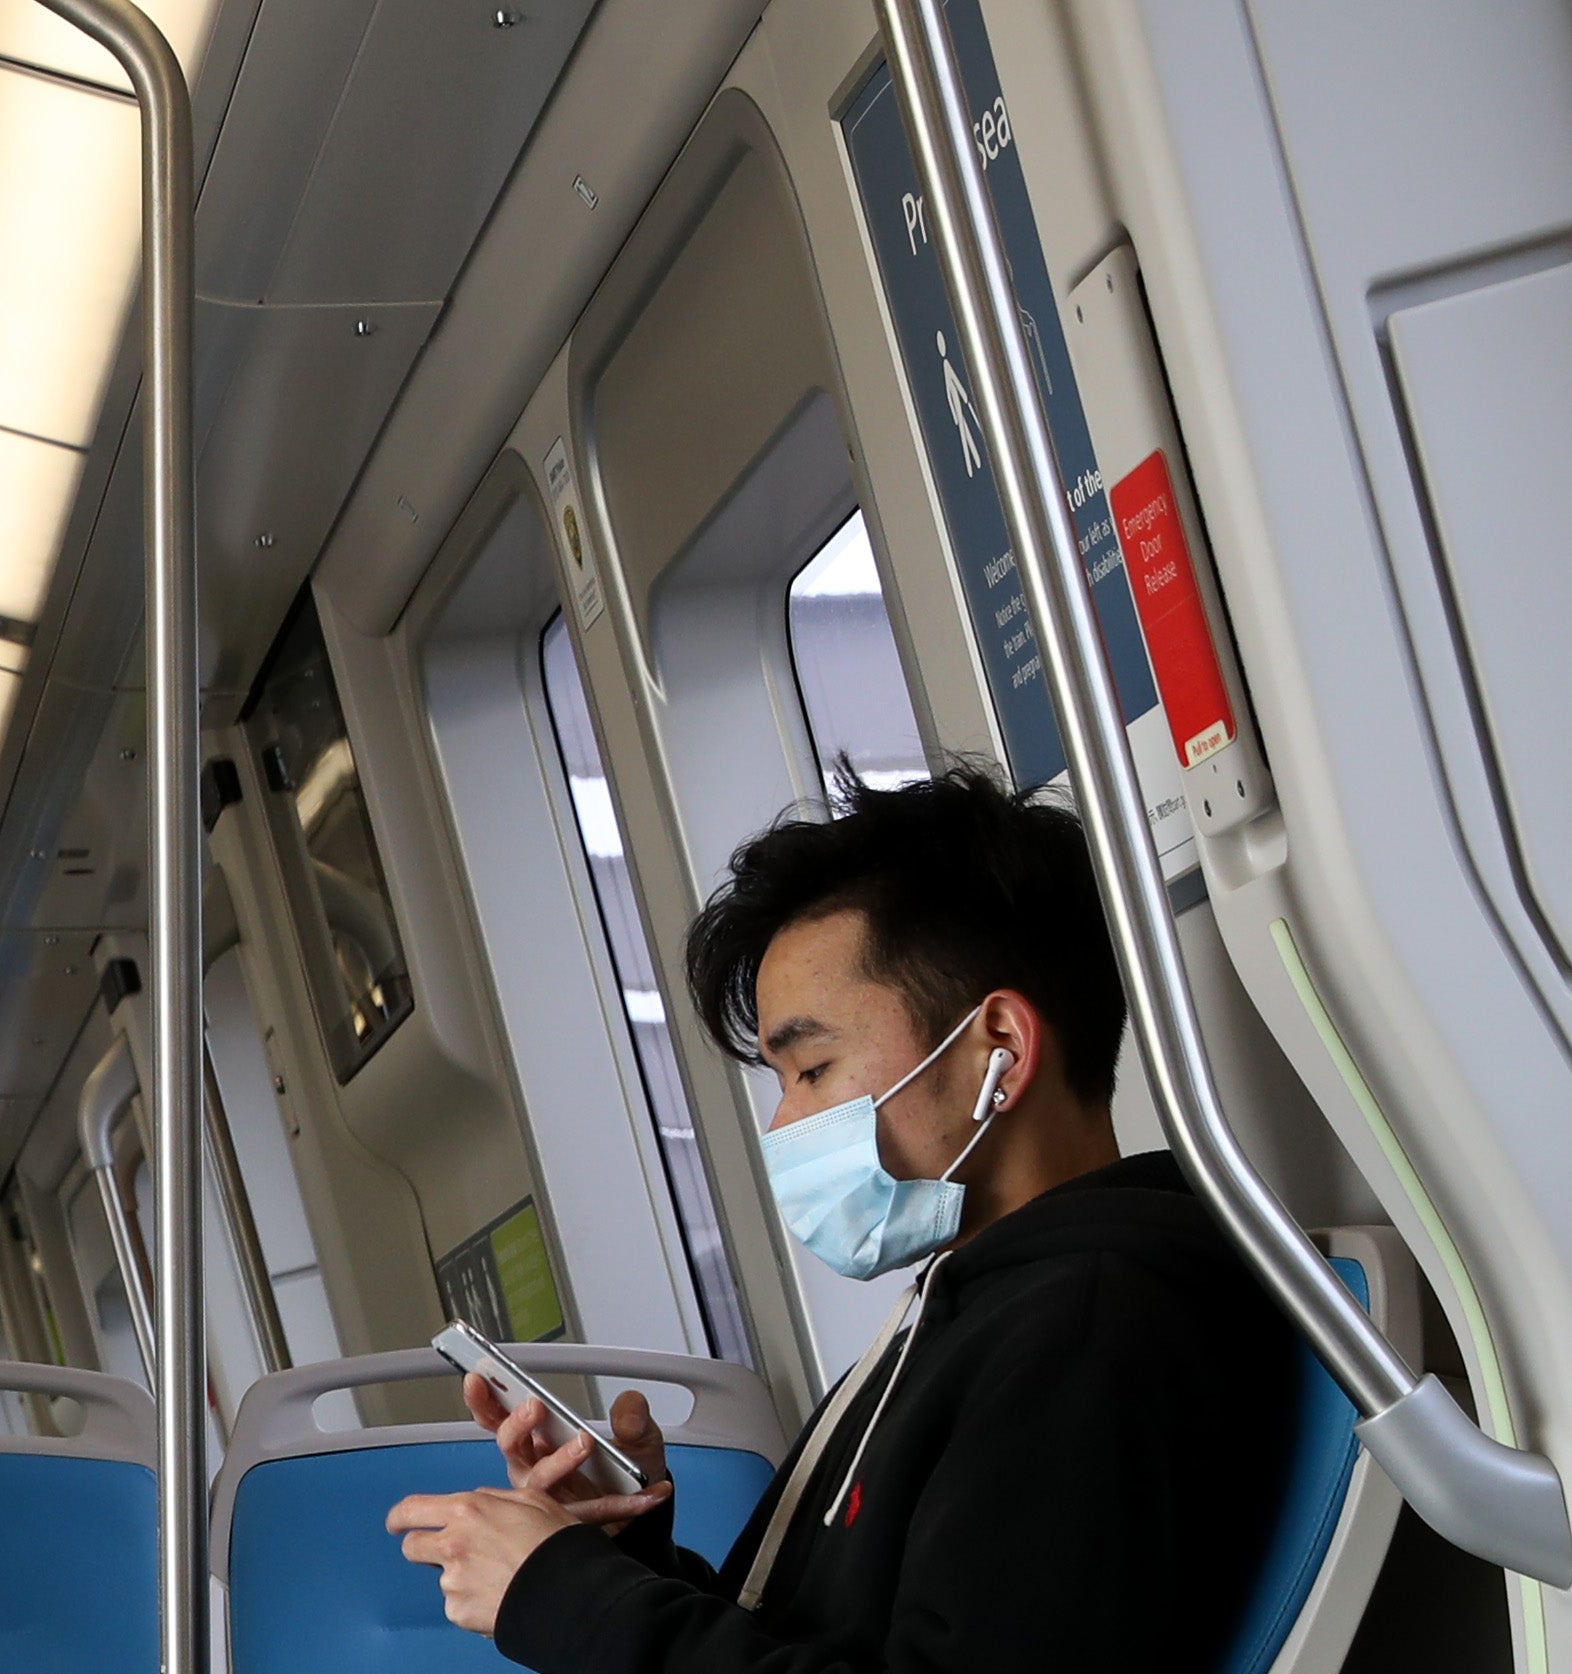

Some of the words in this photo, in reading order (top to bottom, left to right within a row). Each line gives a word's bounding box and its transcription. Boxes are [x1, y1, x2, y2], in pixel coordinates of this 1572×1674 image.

[973, 96, 1012, 171] sea
[1073, 476, 1086, 508] of
[1084, 469, 1103, 498] the
[1122, 493, 1168, 540] Emergency
[1092, 546, 1123, 583] disabilitie
[1140, 534, 1162, 563] Door
[1144, 561, 1178, 597] Release
